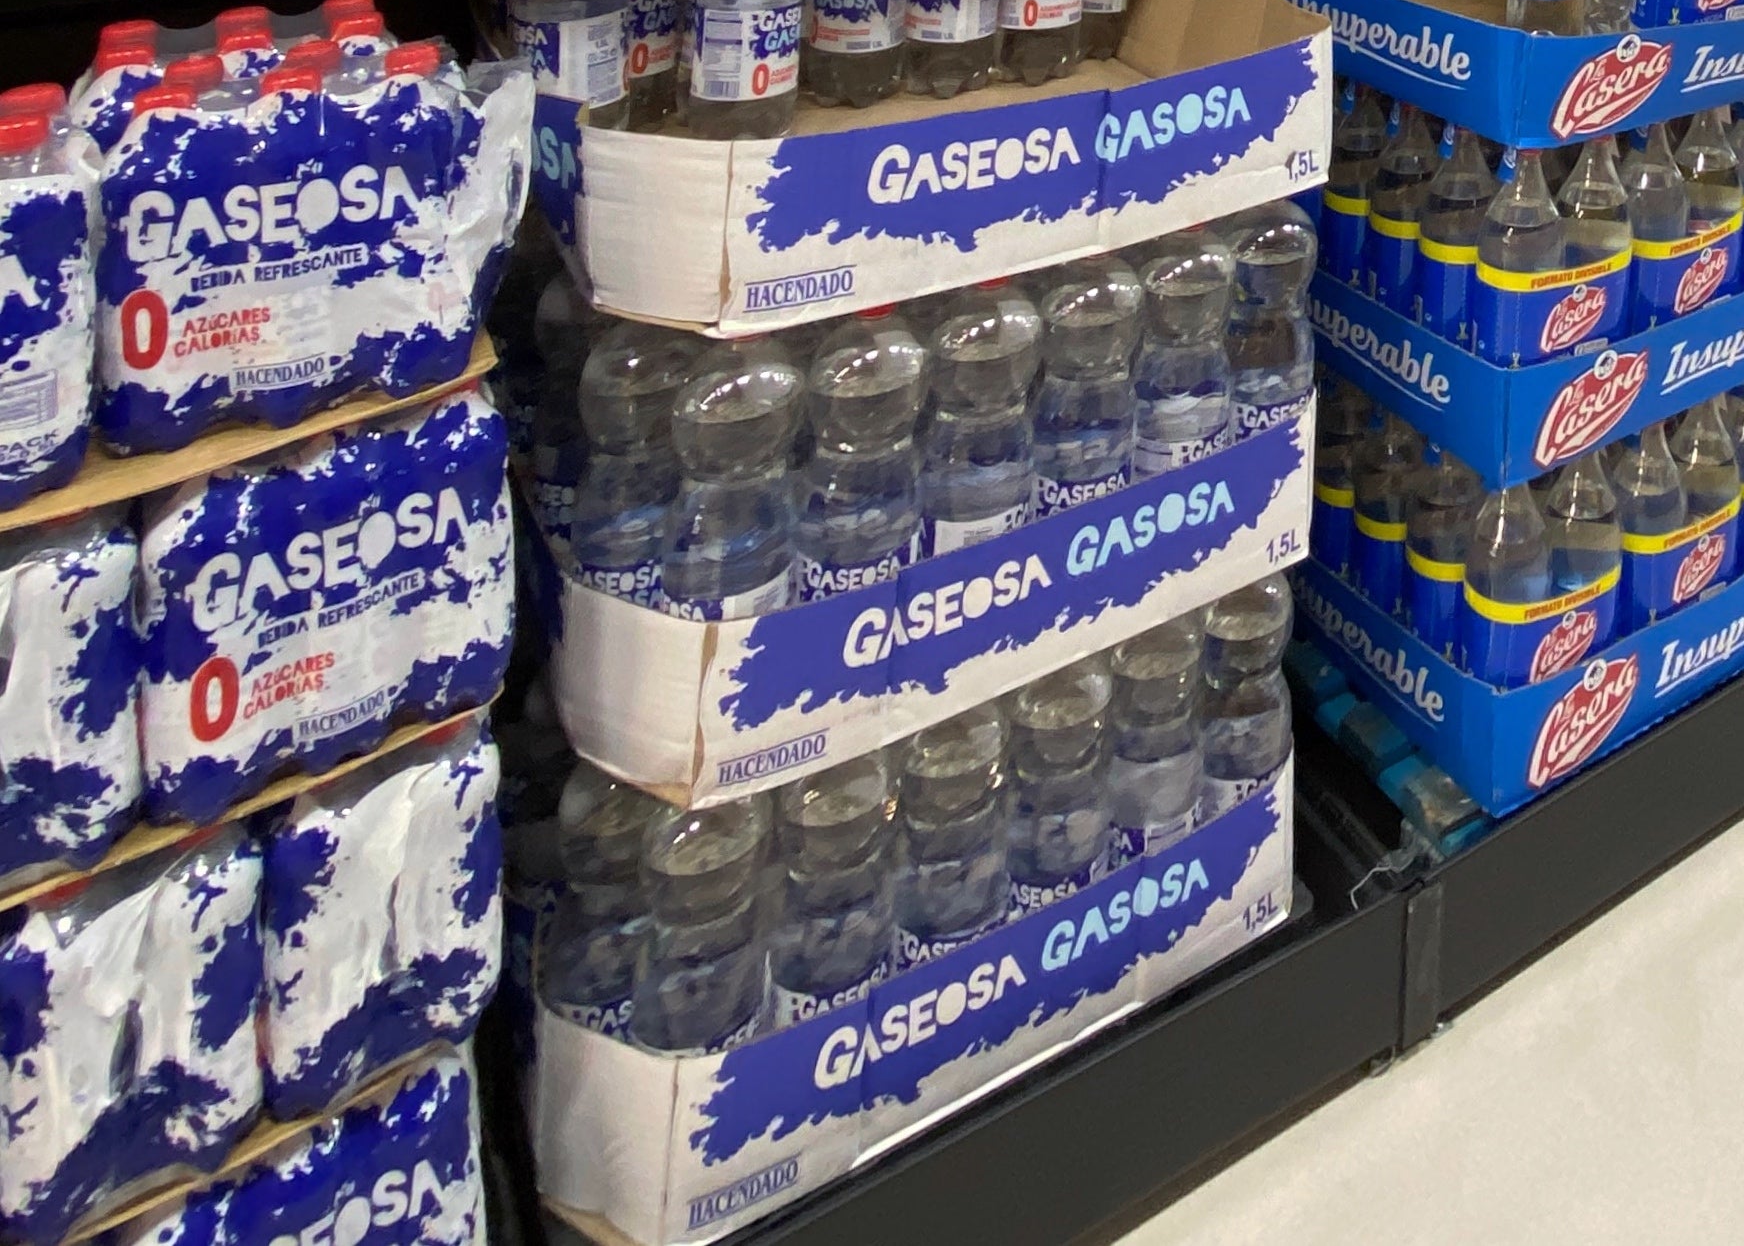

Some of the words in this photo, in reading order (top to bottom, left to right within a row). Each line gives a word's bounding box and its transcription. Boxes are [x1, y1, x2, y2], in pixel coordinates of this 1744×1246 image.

[752, 63, 770, 95] 0
[1551, 42, 1672, 140] Casera
[866, 127, 1081, 205] GASEOSA
[1093, 85, 1252, 162] GASOSA
[122, 164, 421, 262] GASEOSA
[191, 268, 246, 292] BEBIDA
[254, 247, 364, 283] REFRESCANTE
[747, 268, 855, 312] HACENDADO
[120, 289, 169, 370] 0
[1542, 288, 1607, 352] Casera
[235, 357, 325, 386] HACENDADO
[1534, 356, 1648, 467] Casera
[186, 487, 471, 632] GASEOSA
[842, 554, 1054, 668] GASEOSA
[1066, 480, 1235, 577] GASOSA
[1266, 529, 1303, 565] 1,5L
[257, 618, 311, 647] BEBIDA
[317, 571, 422, 629] REFRESCANTE
[189, 656, 240, 742] 0
[300, 691, 386, 737] HACENDADO
[1527, 658, 1638, 788] Casera
[717, 734, 827, 784] HACENDADO
[1242, 892, 1279, 932] 1,5L
[812, 954, 1026, 1090] GASEOSA
[1040, 858, 1210, 972] GASOSA
[687, 1162, 799, 1228] HACENDADO
